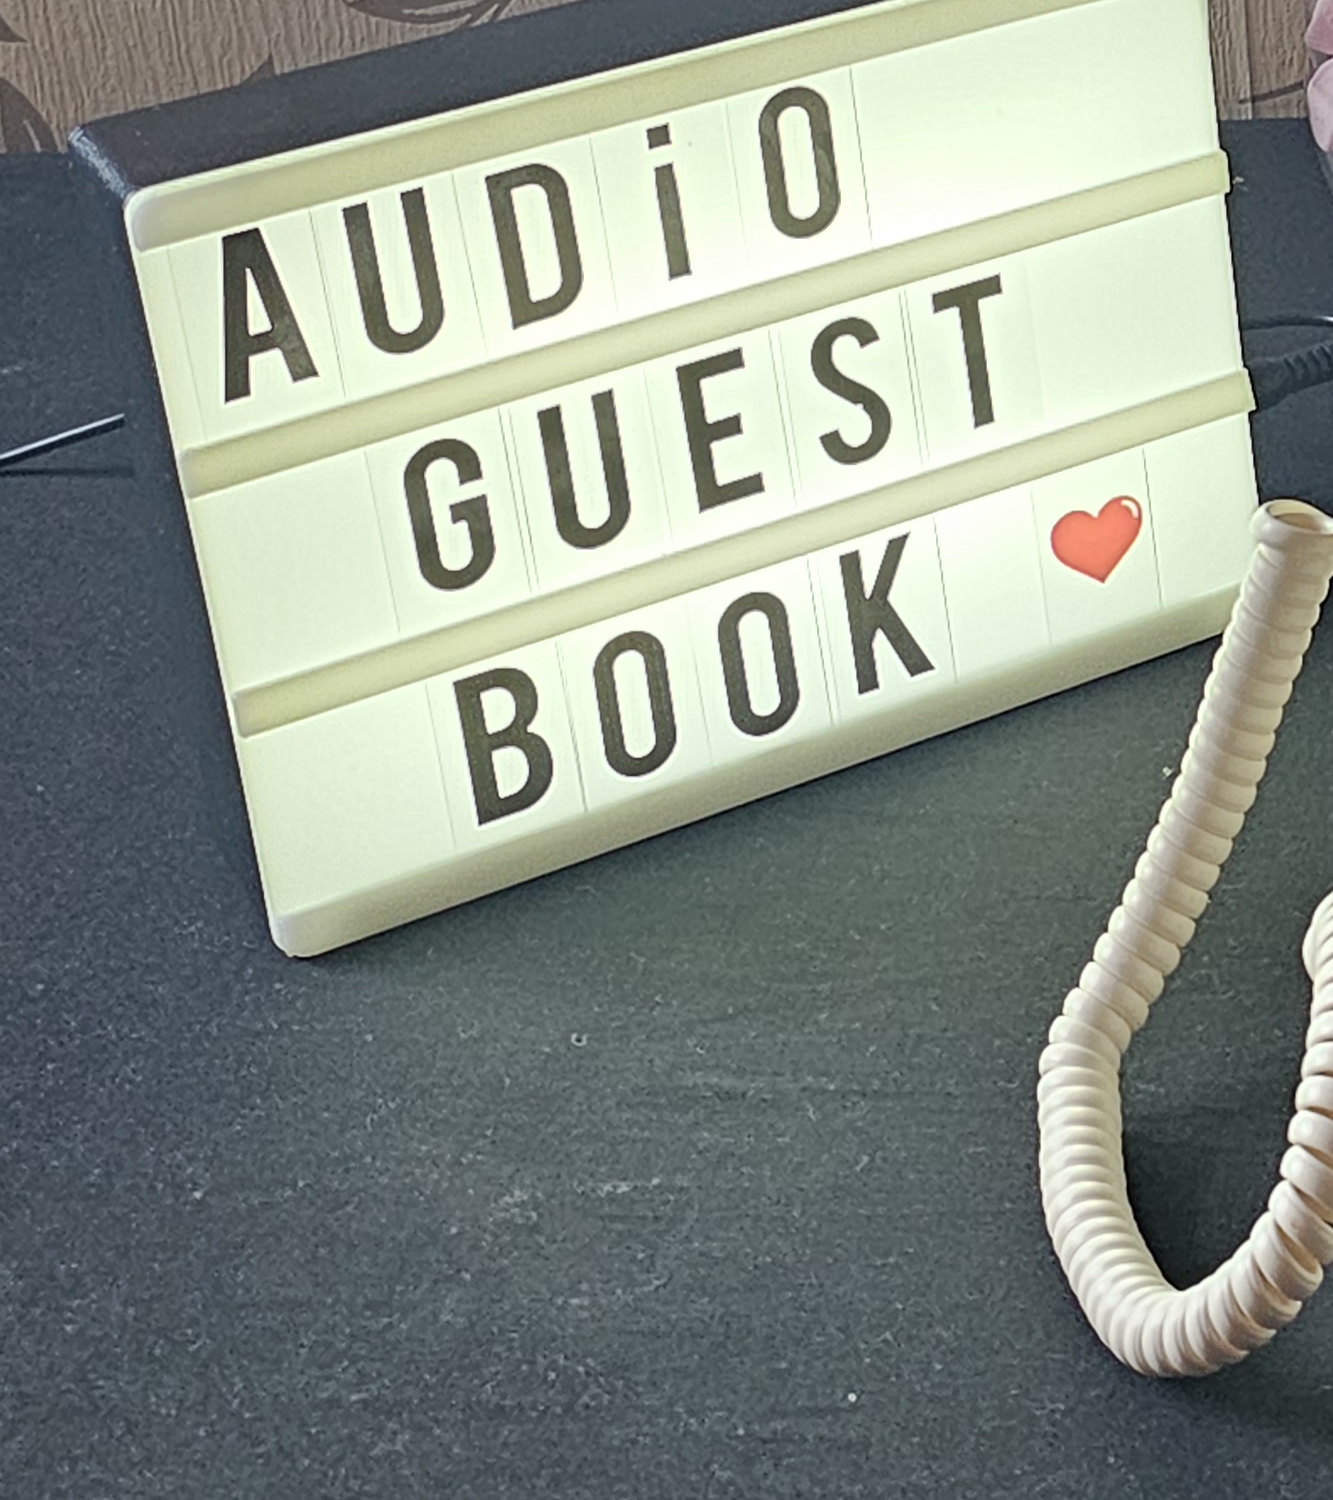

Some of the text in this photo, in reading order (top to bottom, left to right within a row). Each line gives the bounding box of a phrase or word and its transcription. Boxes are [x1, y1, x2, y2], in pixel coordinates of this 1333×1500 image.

[220, 85, 843, 404] AUDiO
[402, 274, 1003, 593] GUEST
[452, 531, 935, 826] BOOK
